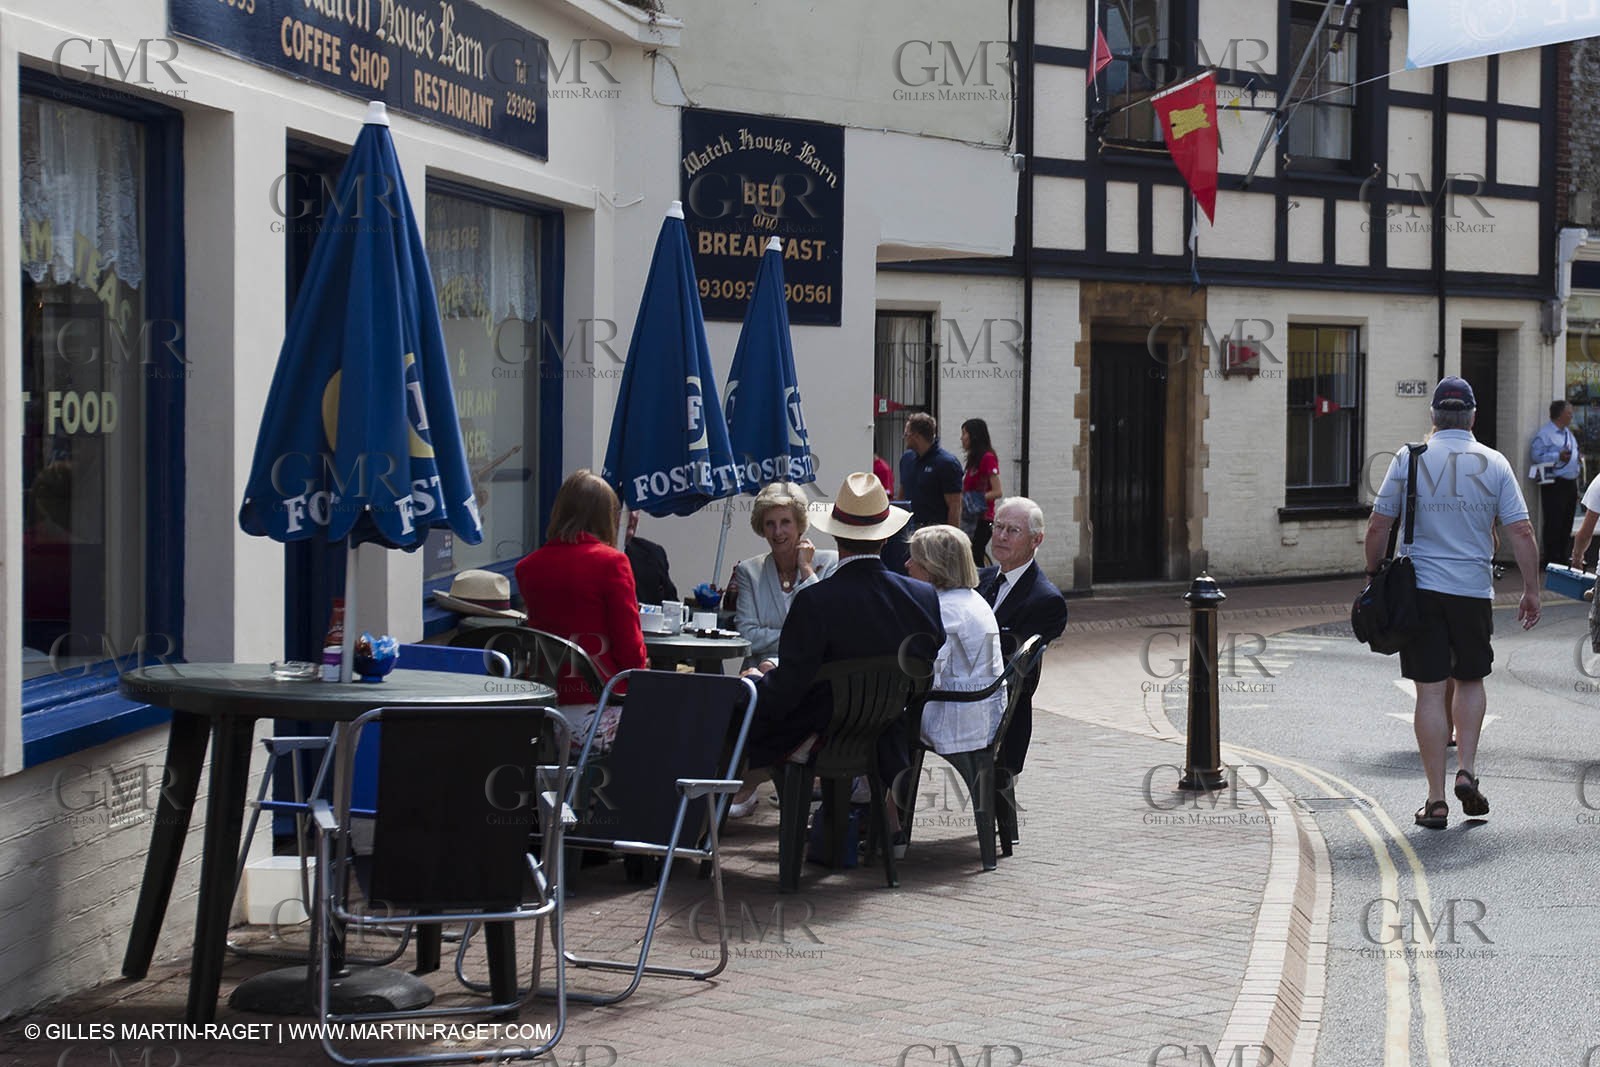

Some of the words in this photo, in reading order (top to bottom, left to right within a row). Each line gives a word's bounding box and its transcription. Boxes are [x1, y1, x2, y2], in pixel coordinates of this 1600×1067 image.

[438, 0, 485, 80] Barn
[280, 16, 342, 76] COFFEE
[350, 43, 390, 91] SHOP
[414, 68, 494, 129] RESTAURANT
[506, 91, 536, 124] 293093
[682, 135, 734, 178] Watch
[738, 128, 792, 155] House
[794, 140, 838, 190] Barn
[743, 181, 786, 208] BED
[752, 213, 779, 231] and
[698, 231, 827, 262] BREAKAST
[1397, 382, 1416, 394] HIGH
[48, 391, 118, 435] FOOD
